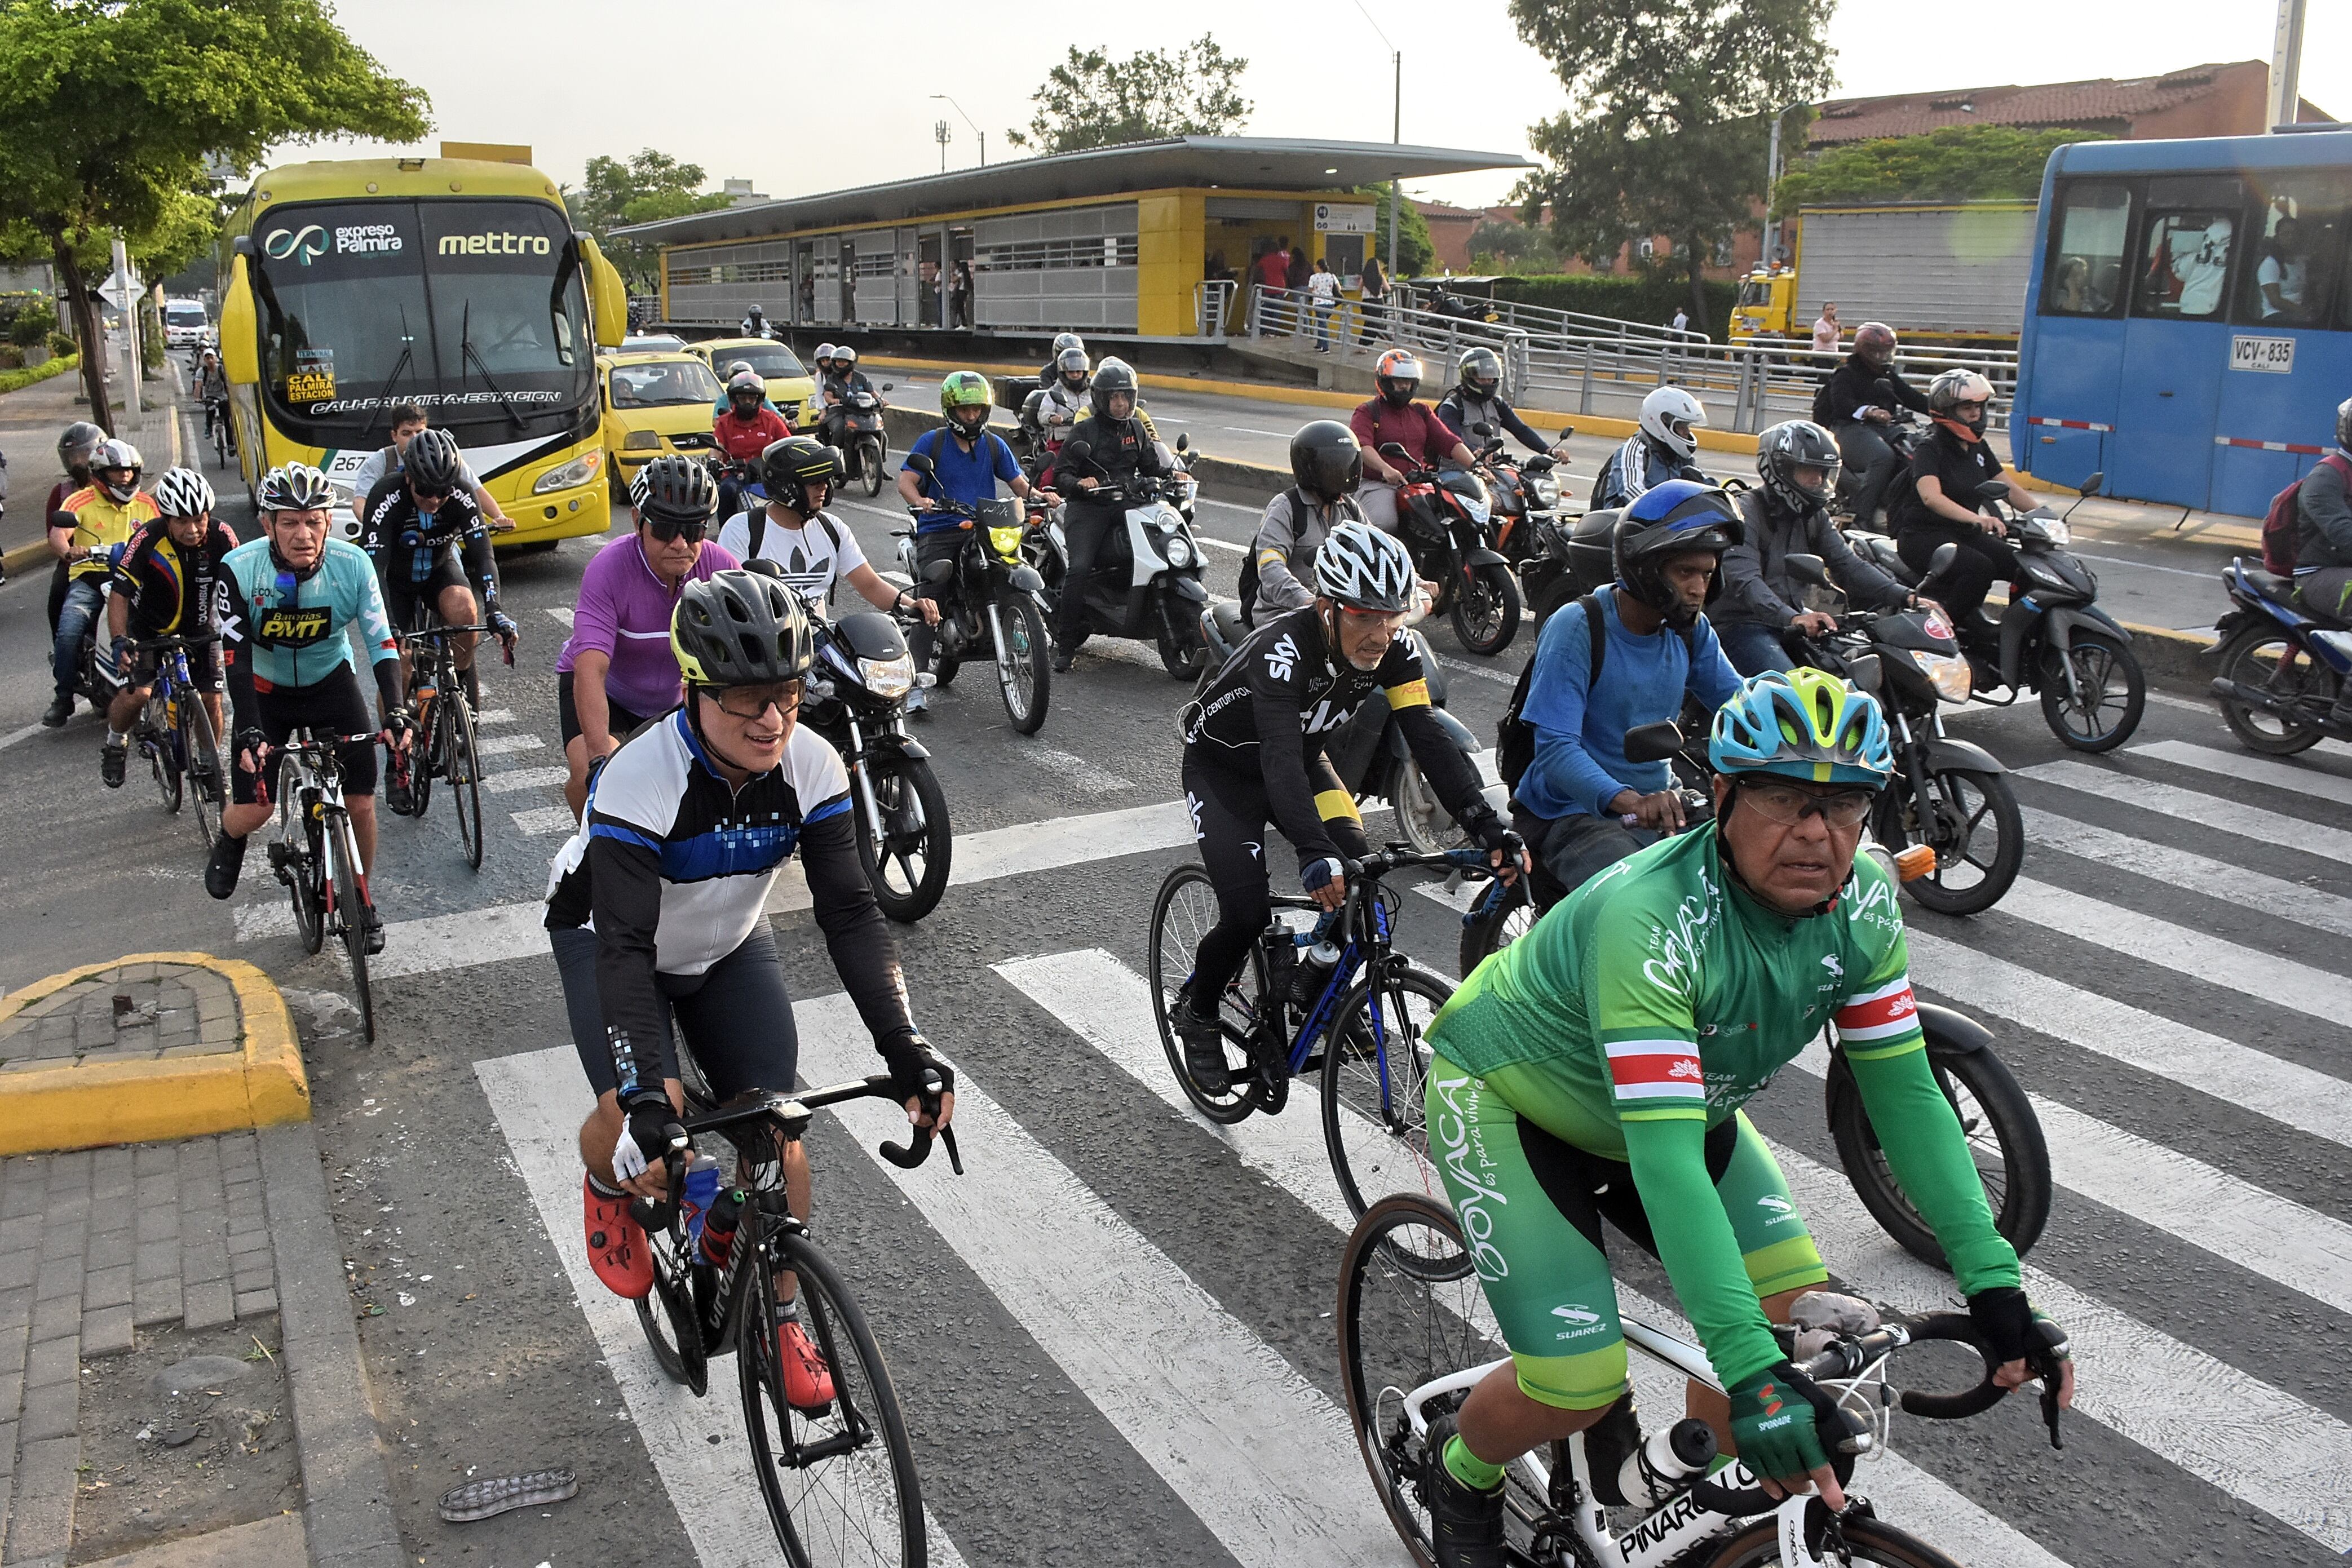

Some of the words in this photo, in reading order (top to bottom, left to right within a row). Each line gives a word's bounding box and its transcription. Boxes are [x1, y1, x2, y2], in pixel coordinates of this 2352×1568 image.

[335, 224, 394, 239] expreso
[336, 236, 402, 254] Palmira
[439, 232, 550, 254] mettro
[289, 373, 333, 384] CALI
[290, 381, 333, 392] PALMIRA
[290, 389, 334, 400] ESTACION
[334, 457, 368, 471] 267
[371, 489, 401, 526] zoover
[120, 528, 149, 569] POSTOBON
[330, 549, 353, 560] BORA
[262, 618, 328, 638] PMT
[1206, 690, 1236, 716] CENTURY
[1235, 686, 1252, 699] FOX
[1650, 925, 1661, 950] TEAM
[1469, 1126, 1498, 1169] para
[1485, 1172, 1497, 1186] es
[1765, 1212, 1797, 1226] SUAREZ
[1556, 1323, 1606, 1340] SUAREZ
